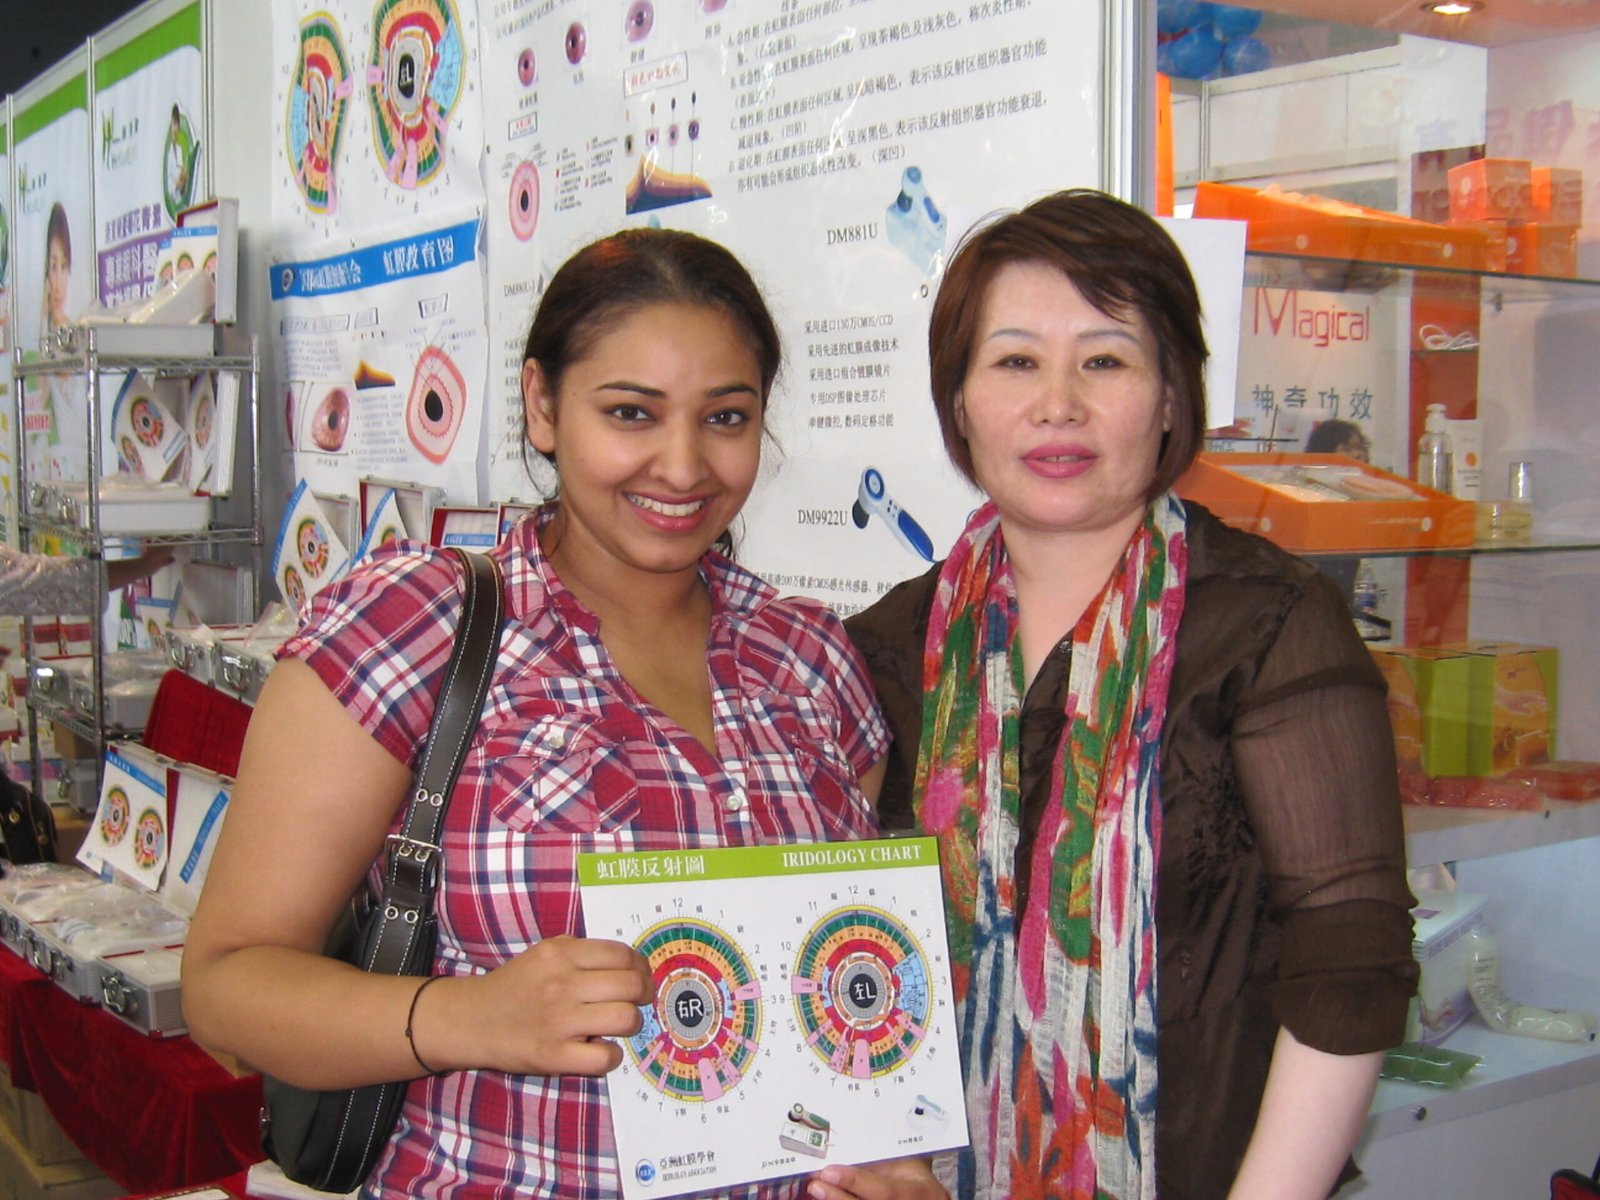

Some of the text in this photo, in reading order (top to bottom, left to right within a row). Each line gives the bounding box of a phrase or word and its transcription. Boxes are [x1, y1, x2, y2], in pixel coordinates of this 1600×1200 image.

[827, 222, 879, 245] DM881U
[1253, 286, 1370, 348] Magical
[1251, 383, 1374, 420] 神奇功效
[798, 509, 849, 527] DM9922U
[782, 844, 923, 868] IRIDOLOGY CHART
[597, 855, 706, 880] 虹膜反射圖
[848, 885, 860, 895] 12
[672, 897, 684, 908] 12
[808, 901, 818, 911] 11
[631, 914, 641, 924] 11
[926, 929, 932, 938] 2
[755, 944, 761, 954] 2
[781, 941, 792, 951] 10
[677, 998, 703, 1019] 右R
[830, 1078, 836, 1087] 7
[874, 1089, 880, 1098] 6
[658, 1102, 664, 1111] 7
[701, 1114, 707, 1124] 6
